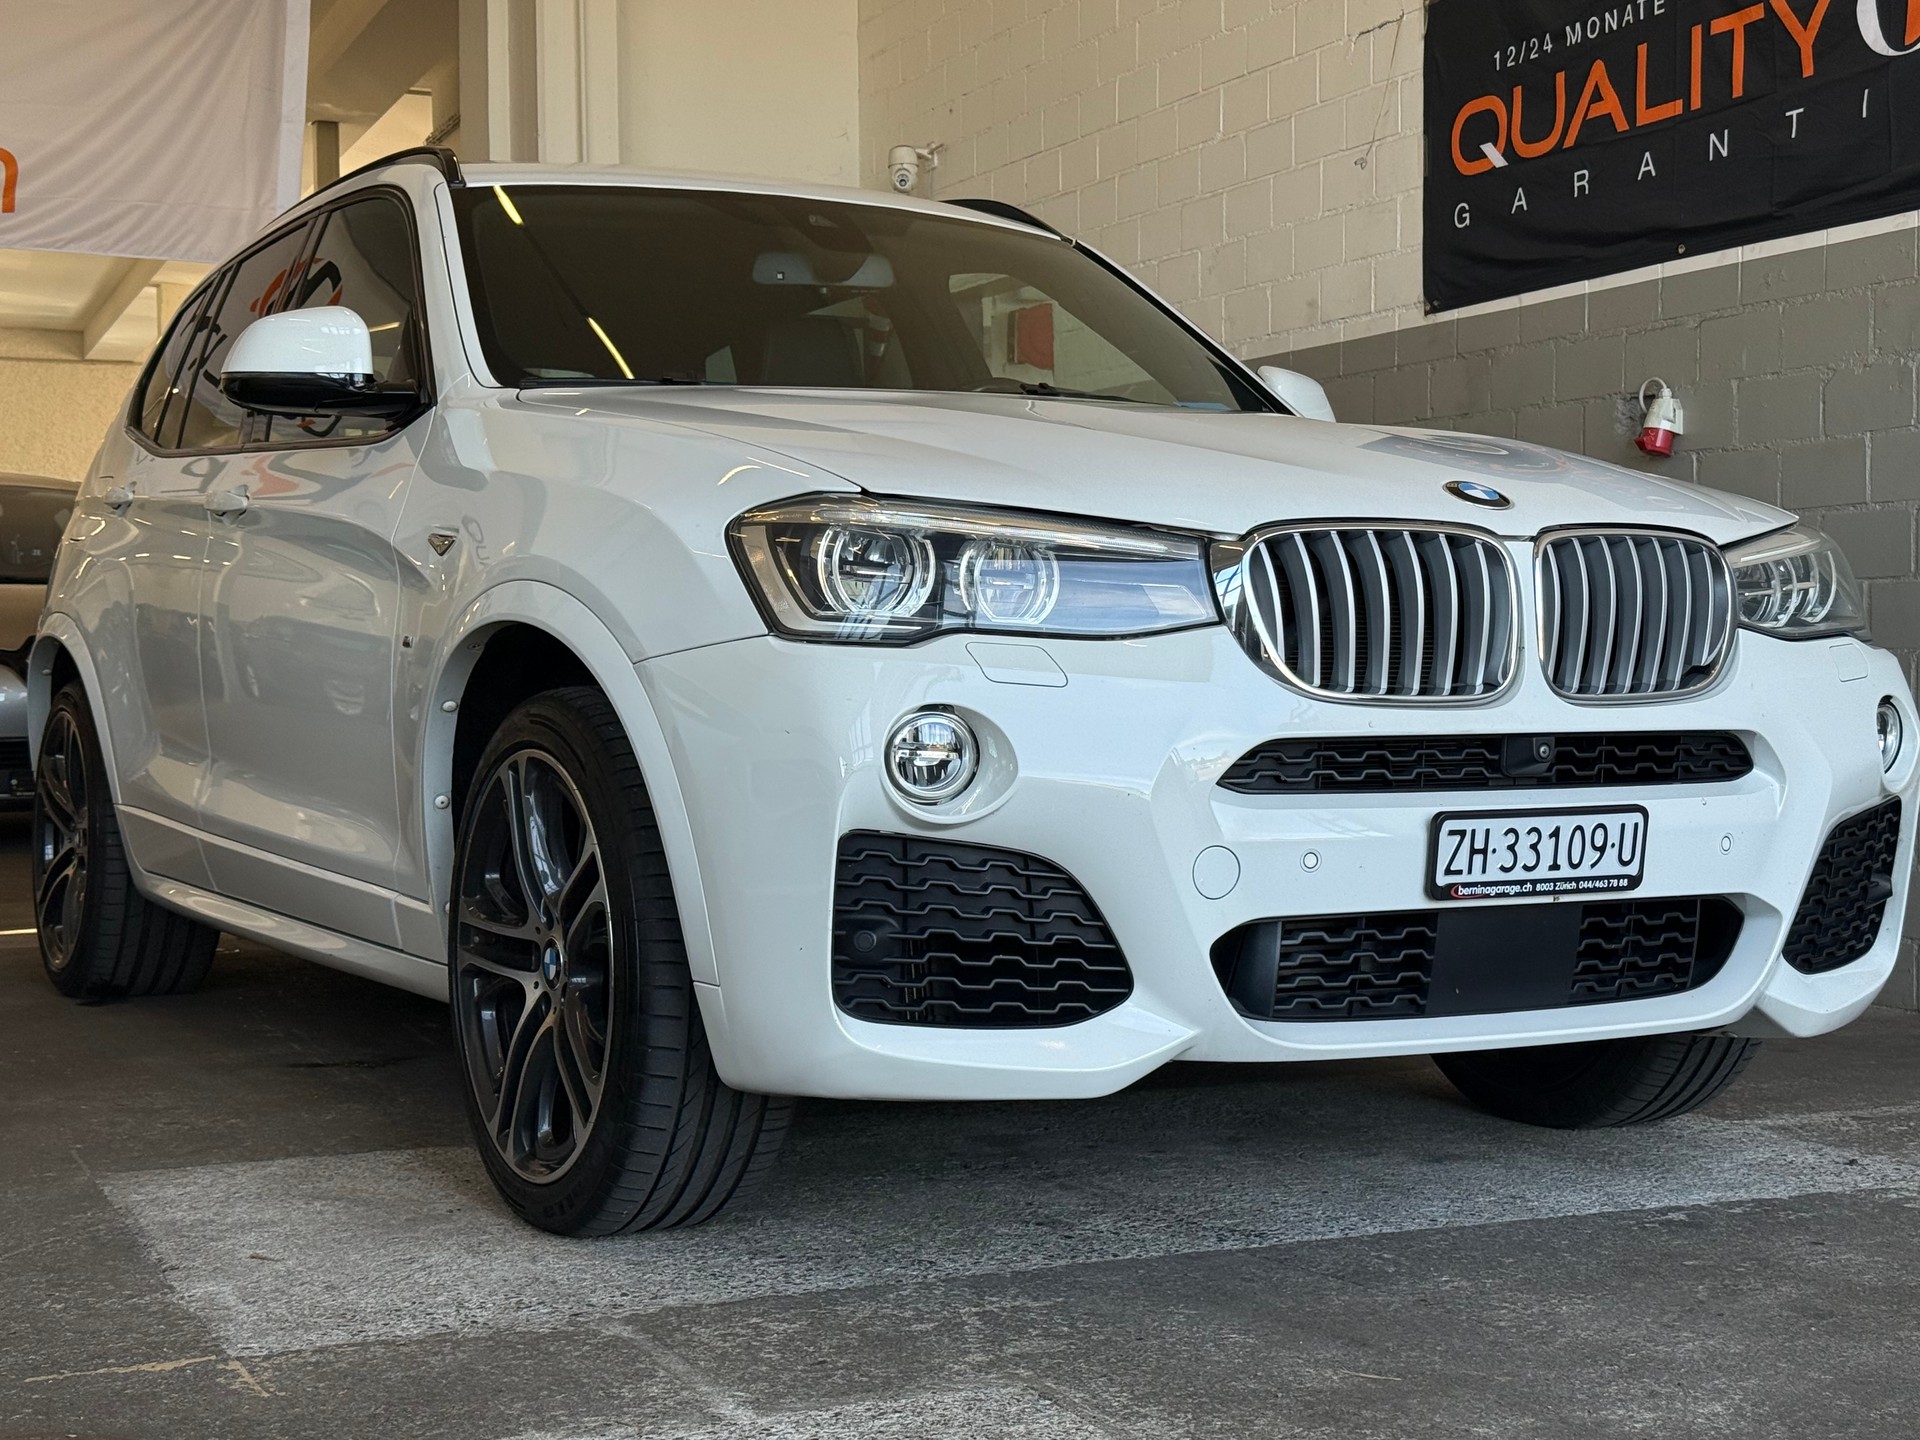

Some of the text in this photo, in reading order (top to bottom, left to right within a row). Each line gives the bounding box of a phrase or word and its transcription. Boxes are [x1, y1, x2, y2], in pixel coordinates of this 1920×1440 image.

[1494, 0, 1666, 71] 12/24 MONATE
[1451, 0, 1831, 176] QUALITY
[1458, 882, 1533, 896] berninagarage.ch
[1536, 882, 1554, 892] 8003
[1555, 880, 1577, 891] Zürich
[1578, 879, 1608, 889] 044/463
